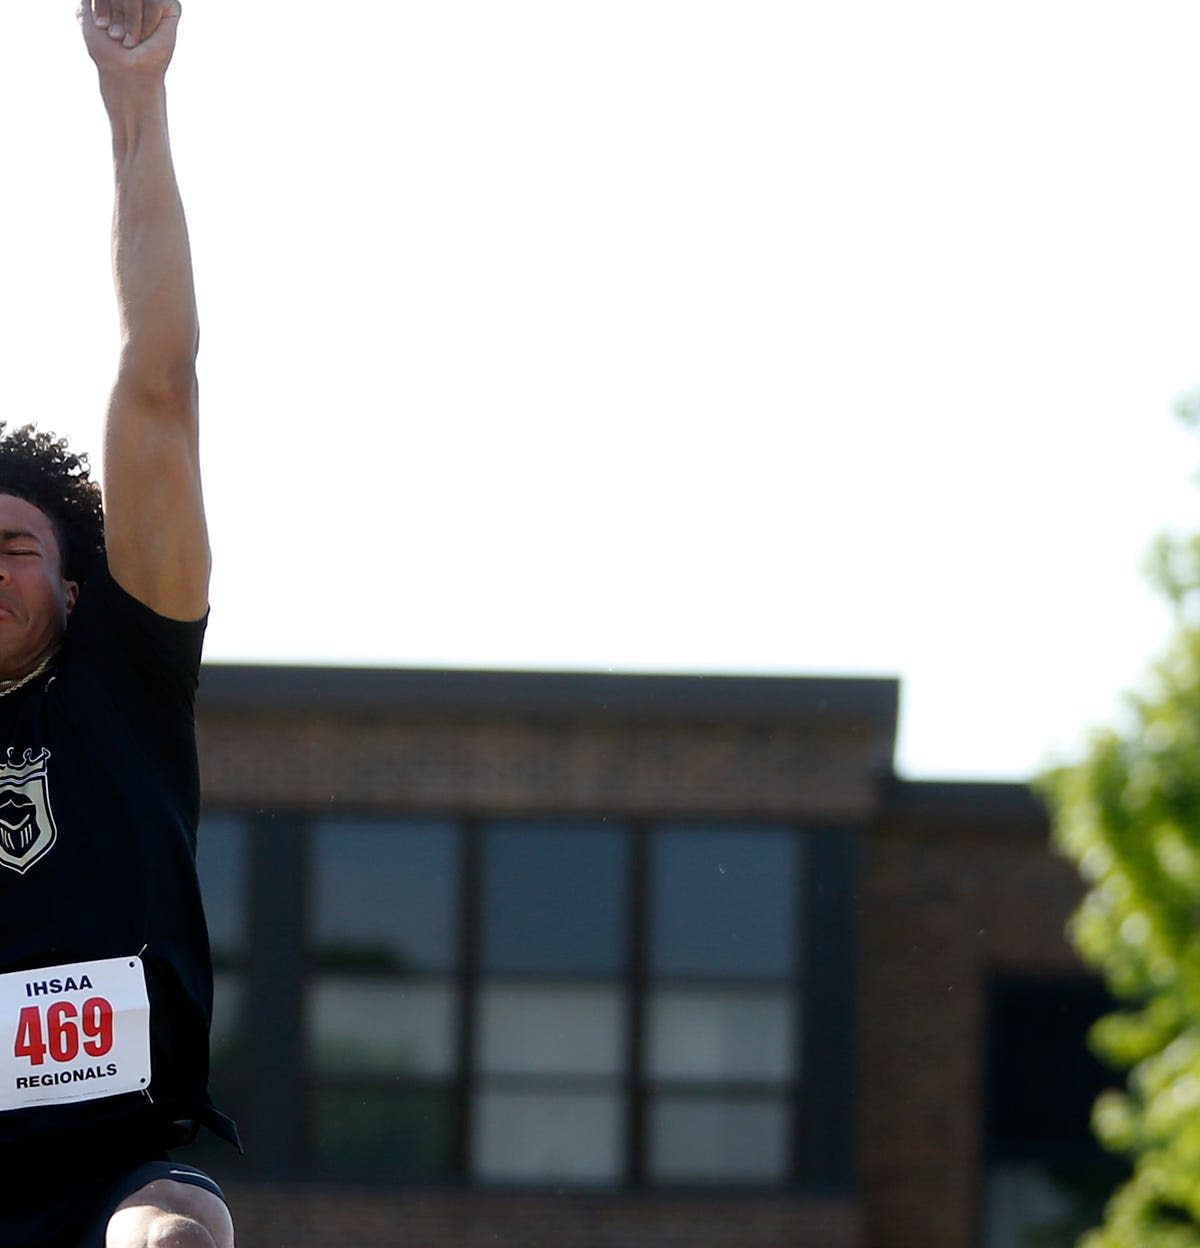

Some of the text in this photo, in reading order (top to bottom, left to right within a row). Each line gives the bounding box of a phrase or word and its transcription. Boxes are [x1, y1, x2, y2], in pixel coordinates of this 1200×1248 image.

[25, 975, 93, 997] IHSAA
[14, 997, 113, 1066] 469
[16, 1063, 118, 1089] REGIONALS
